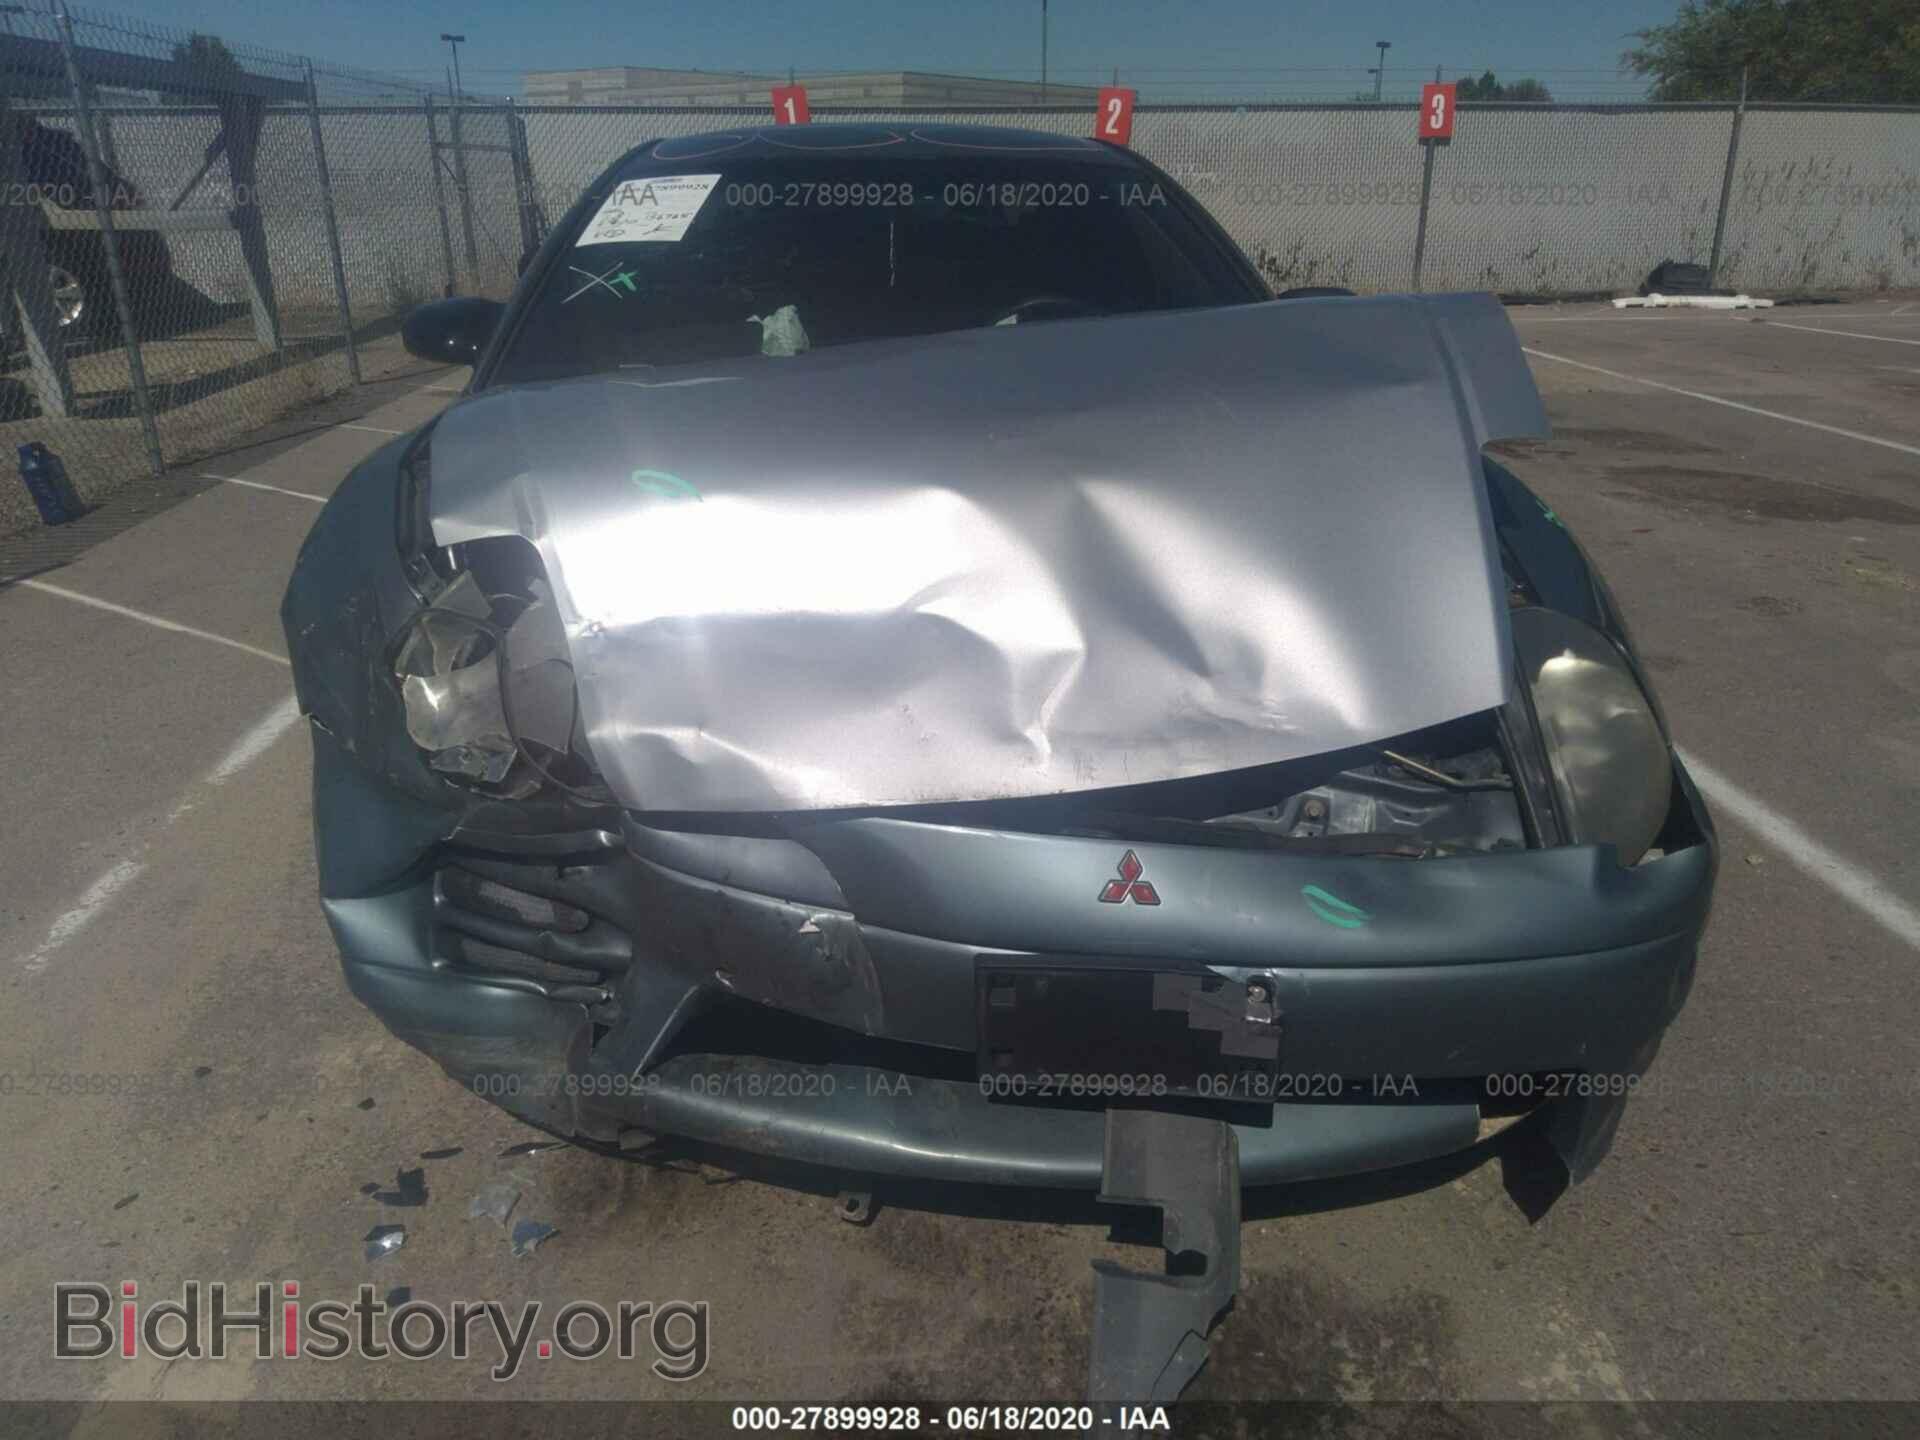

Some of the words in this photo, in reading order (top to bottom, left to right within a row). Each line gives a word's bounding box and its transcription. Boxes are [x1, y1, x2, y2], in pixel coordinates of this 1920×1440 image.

[784, 98, 796, 124] 1
[1105, 98, 1122, 134] 2
[1430, 94, 1445, 129] 3
